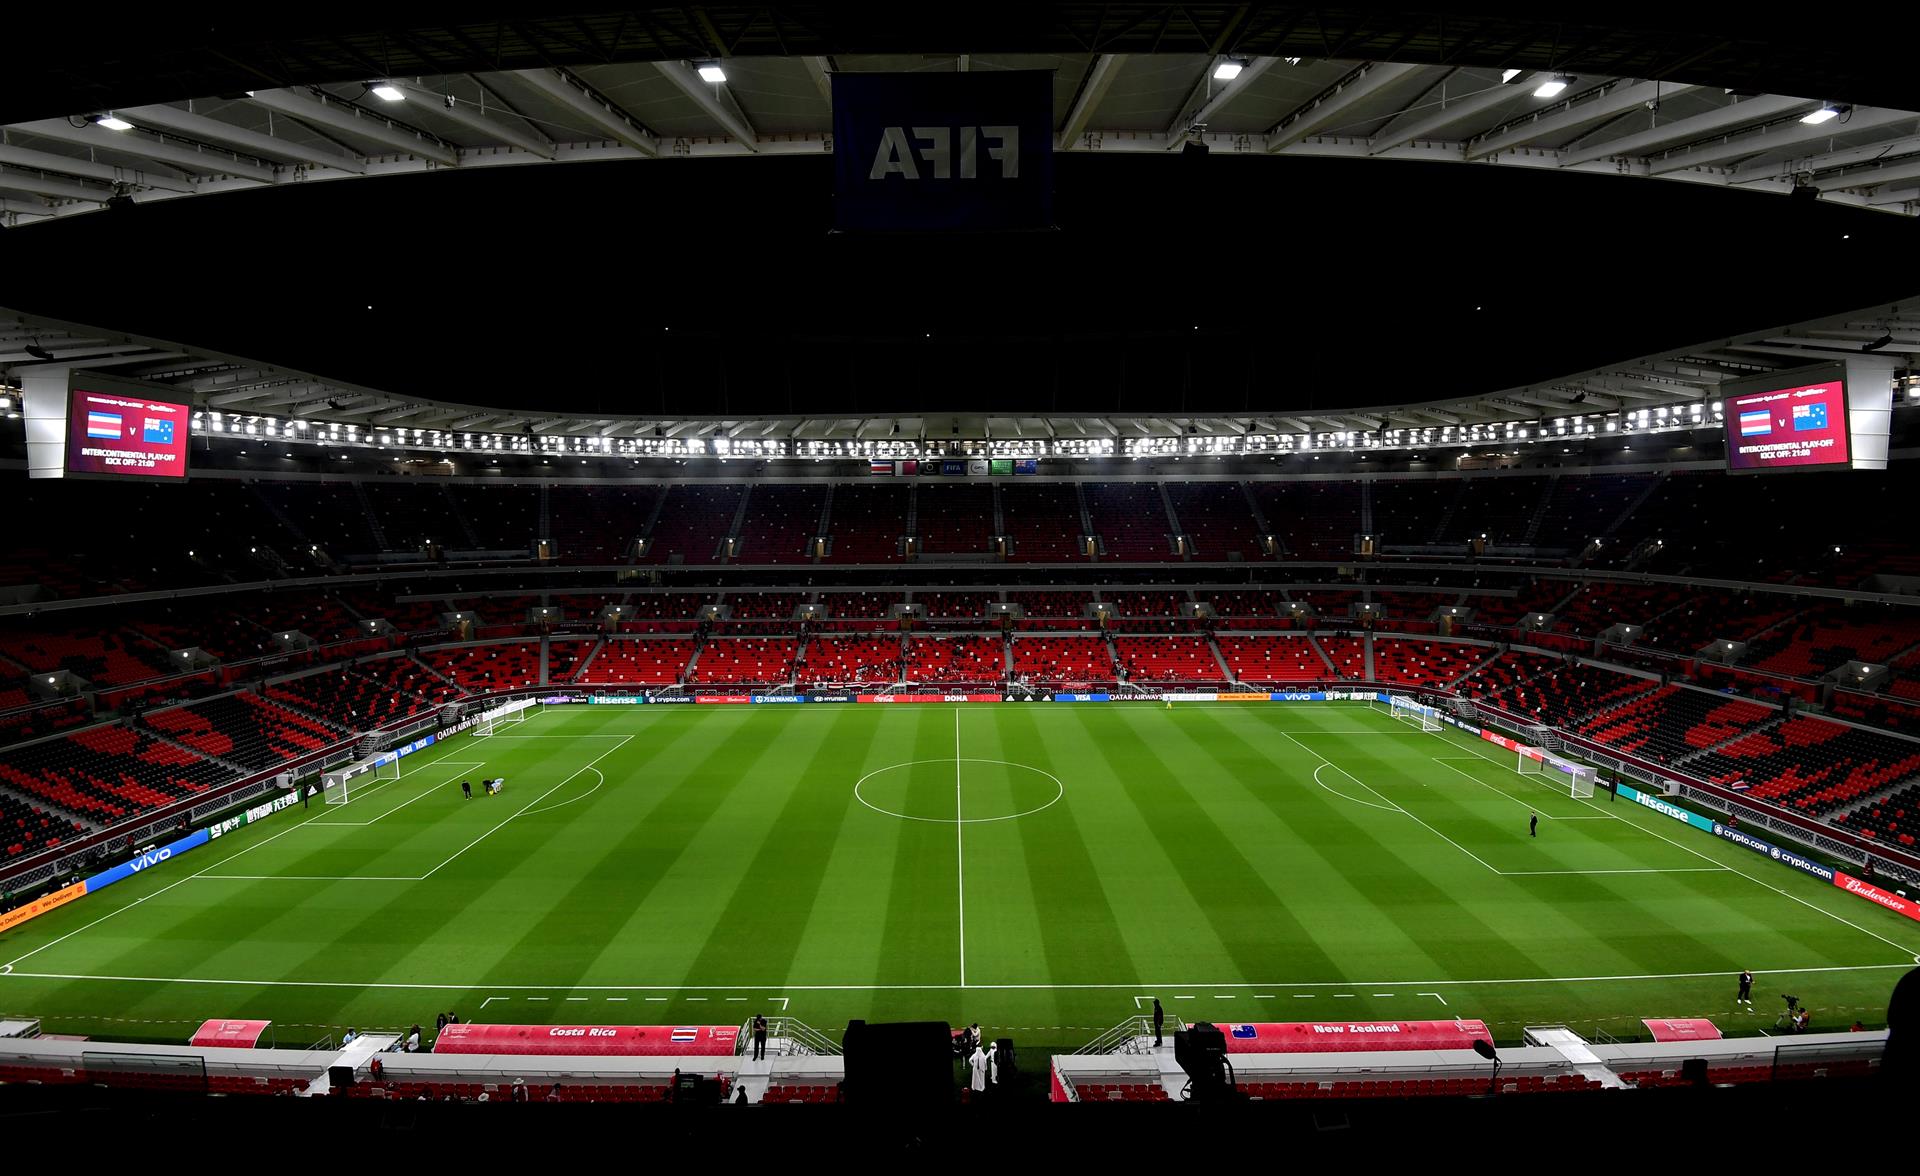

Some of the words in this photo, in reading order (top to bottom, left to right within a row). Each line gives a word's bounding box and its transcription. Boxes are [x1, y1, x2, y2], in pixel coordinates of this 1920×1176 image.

[1739, 442, 1801, 453] INTERCONTINENTAL
[1801, 439, 1834, 448] PLAY-OFF
[82, 448, 146, 460] INTERCONTINENTAL
[148, 453, 176, 462] PLAY-OFF
[594, 696, 637, 704] Hisense
[437, 726, 456, 740] QATAR
[400, 745, 412, 757] VISA
[415, 738, 427, 750] VISA
[1636, 791, 1689, 823] Hisense
[1724, 828, 1768, 853] crypto.com
[130, 848, 171, 872] vivo
[1782, 854, 1832, 880] crypto.com
[42, 900, 52, 908] We
[52, 891, 73, 904] Deliver
[1845, 876, 1905, 911] Budweiser
[549, 1027, 586, 1036] Costa
[588, 1028, 617, 1037] Rica
[1313, 1024, 1344, 1033] New
[1348, 1024, 1400, 1033] Zealand
